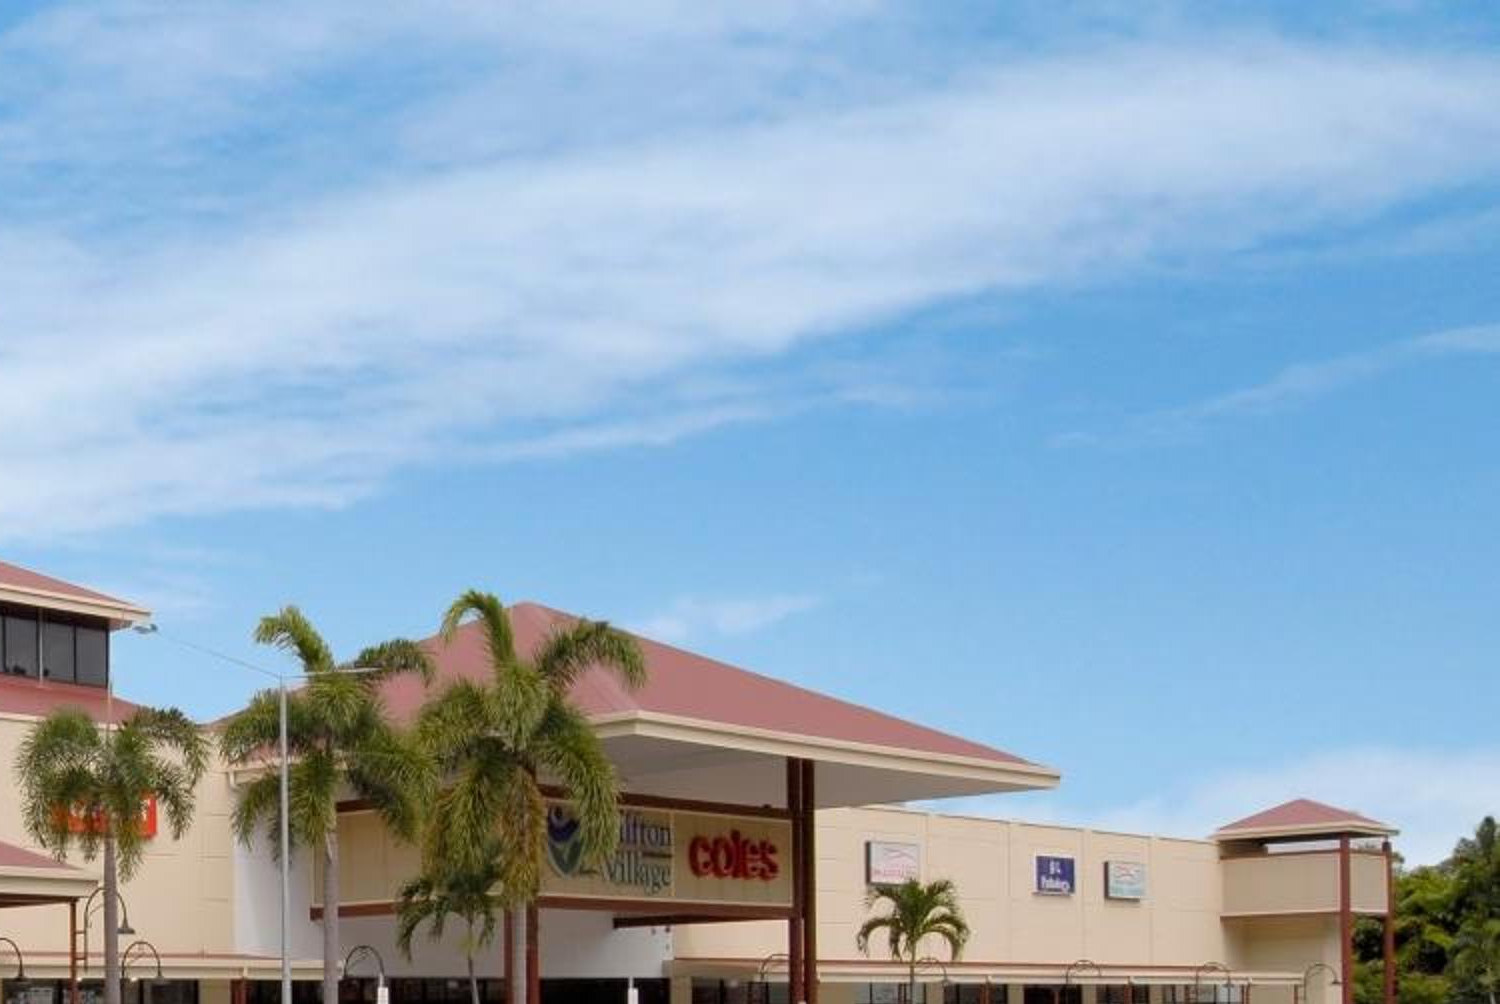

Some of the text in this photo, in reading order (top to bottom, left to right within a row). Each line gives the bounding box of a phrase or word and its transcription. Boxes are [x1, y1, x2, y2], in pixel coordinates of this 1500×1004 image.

[618, 808, 671, 848] lifton
[602, 850, 671, 893] Village
[688, 829, 779, 881] coles
